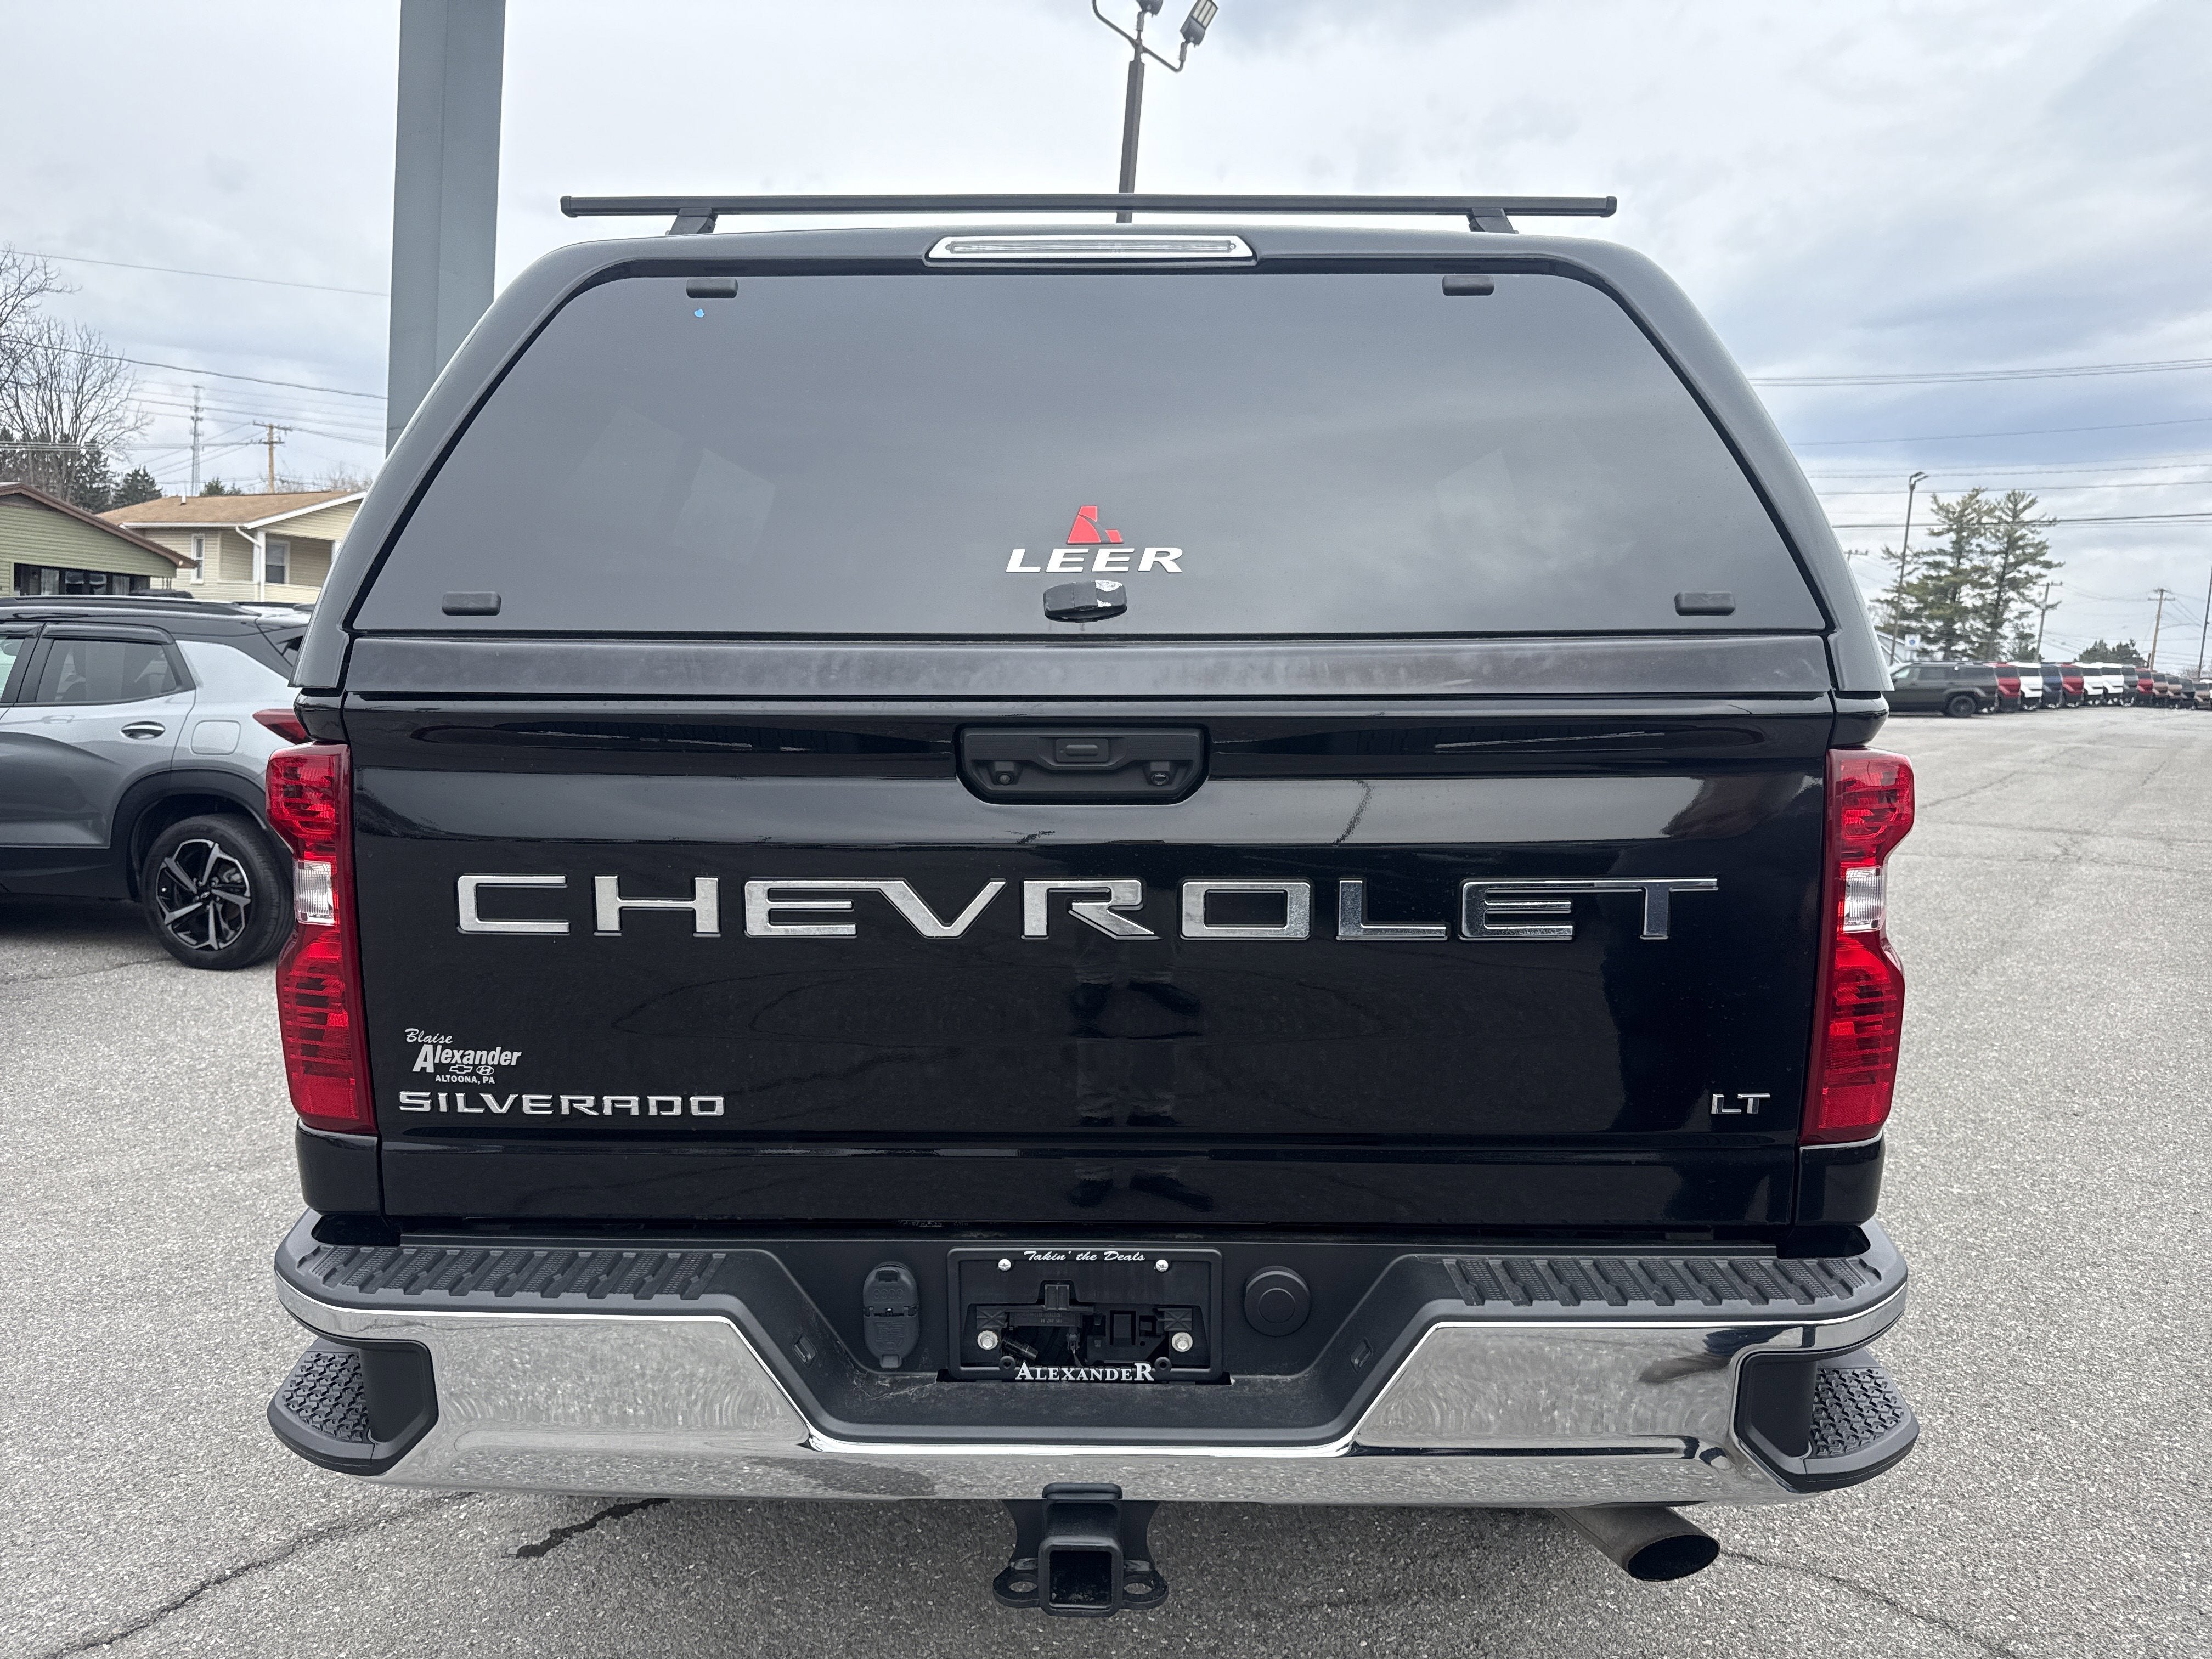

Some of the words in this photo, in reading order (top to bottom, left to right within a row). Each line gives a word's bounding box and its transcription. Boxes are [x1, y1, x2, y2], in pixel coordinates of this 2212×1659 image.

[1006, 547, 1183, 573] LEER
[457, 874, 1718, 939] CHEVROLET
[405, 1028, 453, 1045] Blaise
[412, 1044, 522, 1073] Alexander
[435, 1074, 482, 1085] ALTOONA,
[483, 1076, 495, 1084] PA
[398, 1091, 725, 1116] SILVERADO
[1711, 1093, 1771, 1114] LT
[1076, 1251, 1097, 1261] the
[1103, 1251, 1146, 1261] Deals
[1015, 1362, 1154, 1381] ALEXANDER
